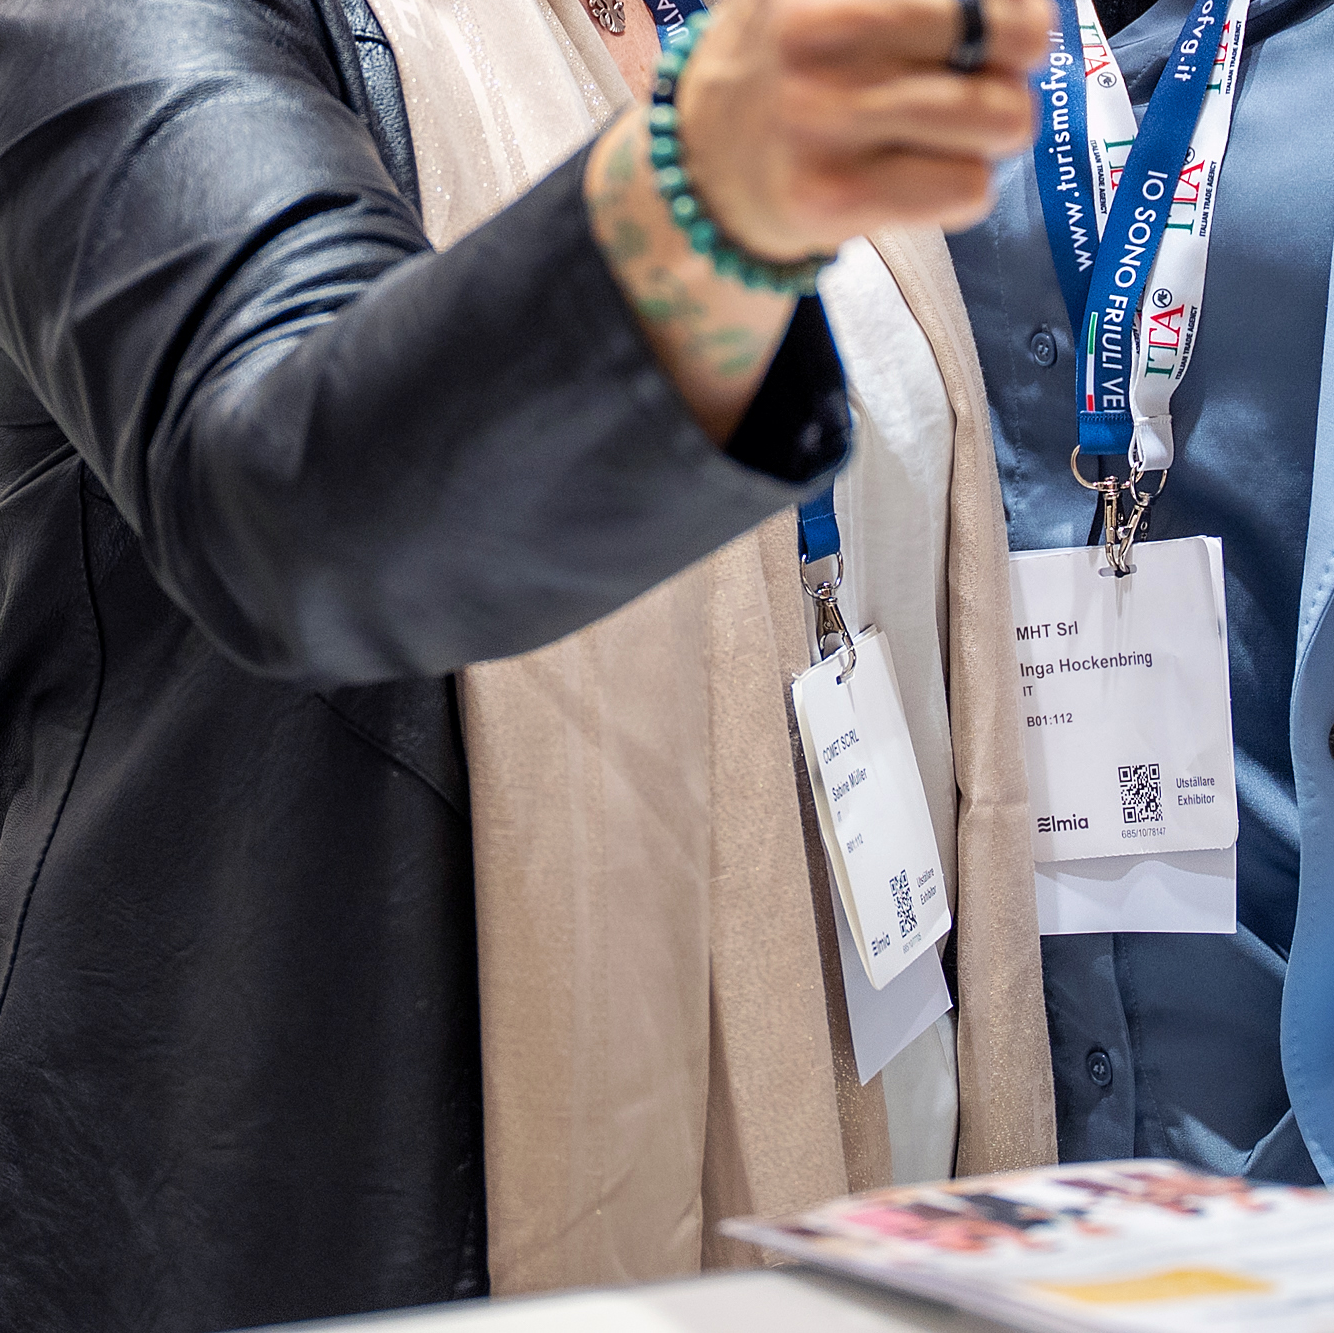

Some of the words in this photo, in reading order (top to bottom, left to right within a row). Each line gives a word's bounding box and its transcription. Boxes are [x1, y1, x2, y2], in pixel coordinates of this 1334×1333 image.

[1233, 20, 1242, 46] AGENCY
[1229, 48, 1238, 68] TRADE
[1225, 69, 1233, 95] ITALIAN
[1090, 139, 1101, 163] ITALIAN
[1095, 163, 1105, 186] TRADE
[1142, 170, 1168, 201] IO
[1207, 160, 1218, 190] AGENCY
[1099, 187, 1108, 215] AGENCY
[1203, 190, 1213, 213] TRADE
[1199, 212, 1210, 238] ITALIAN
[1114, 206, 1157, 289] SONO
[1186, 305, 1199, 332] AGENCY
[1102, 294, 1129, 370] FRIULI
[1181, 331, 1193, 354] TRADE
[1175, 353, 1188, 380] ITALIAN
[1102, 378, 1125, 414] VE
[1016, 623, 1051, 641] MHT
[1056, 621, 1079, 637] Srl
[1020, 663, 1054, 679] Inga
[1059, 651, 1153, 673] Hockenbring
[1022, 685, 1034, 697] IT
[1027, 712, 1073, 727] B01:112
[823, 739, 842, 765] COMET
[840, 728, 860, 750] SCRL
[1175, 776, 1215, 789] Utställare
[1177, 793, 1215, 806] Exhibitor
[1037, 813, 1089, 833] Elmia
